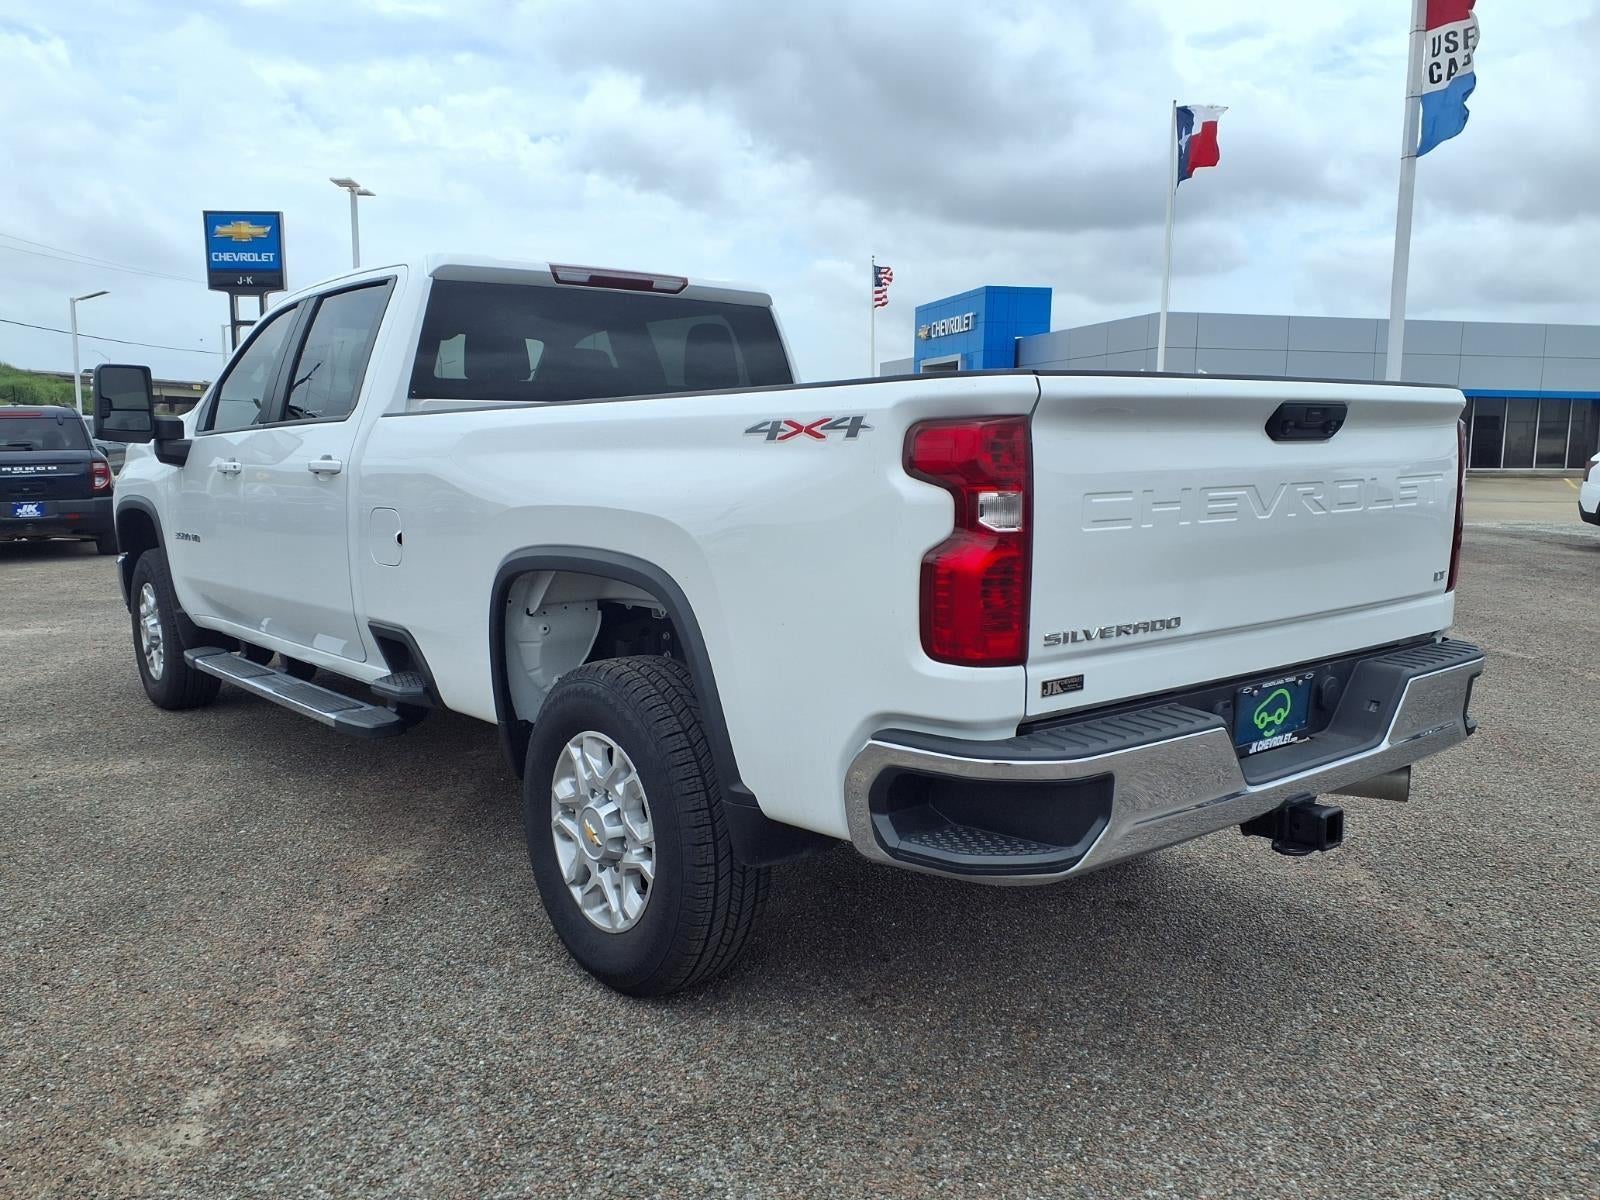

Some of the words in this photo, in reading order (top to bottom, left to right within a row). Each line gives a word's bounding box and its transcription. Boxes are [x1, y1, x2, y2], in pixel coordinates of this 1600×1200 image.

[1431, 25, 1477, 58] USE
[211, 252, 275, 262] CHEVROLET
[237, 276, 253, 285] J-K
[931, 312, 976, 338] CHEVROLET
[17, 504, 38, 513] JK
[1081, 473, 1444, 532] CHEVROLET
[1433, 571, 1446, 582] LT
[1043, 616, 1181, 647] SILVERADO
[1042, 680, 1065, 697] JK
